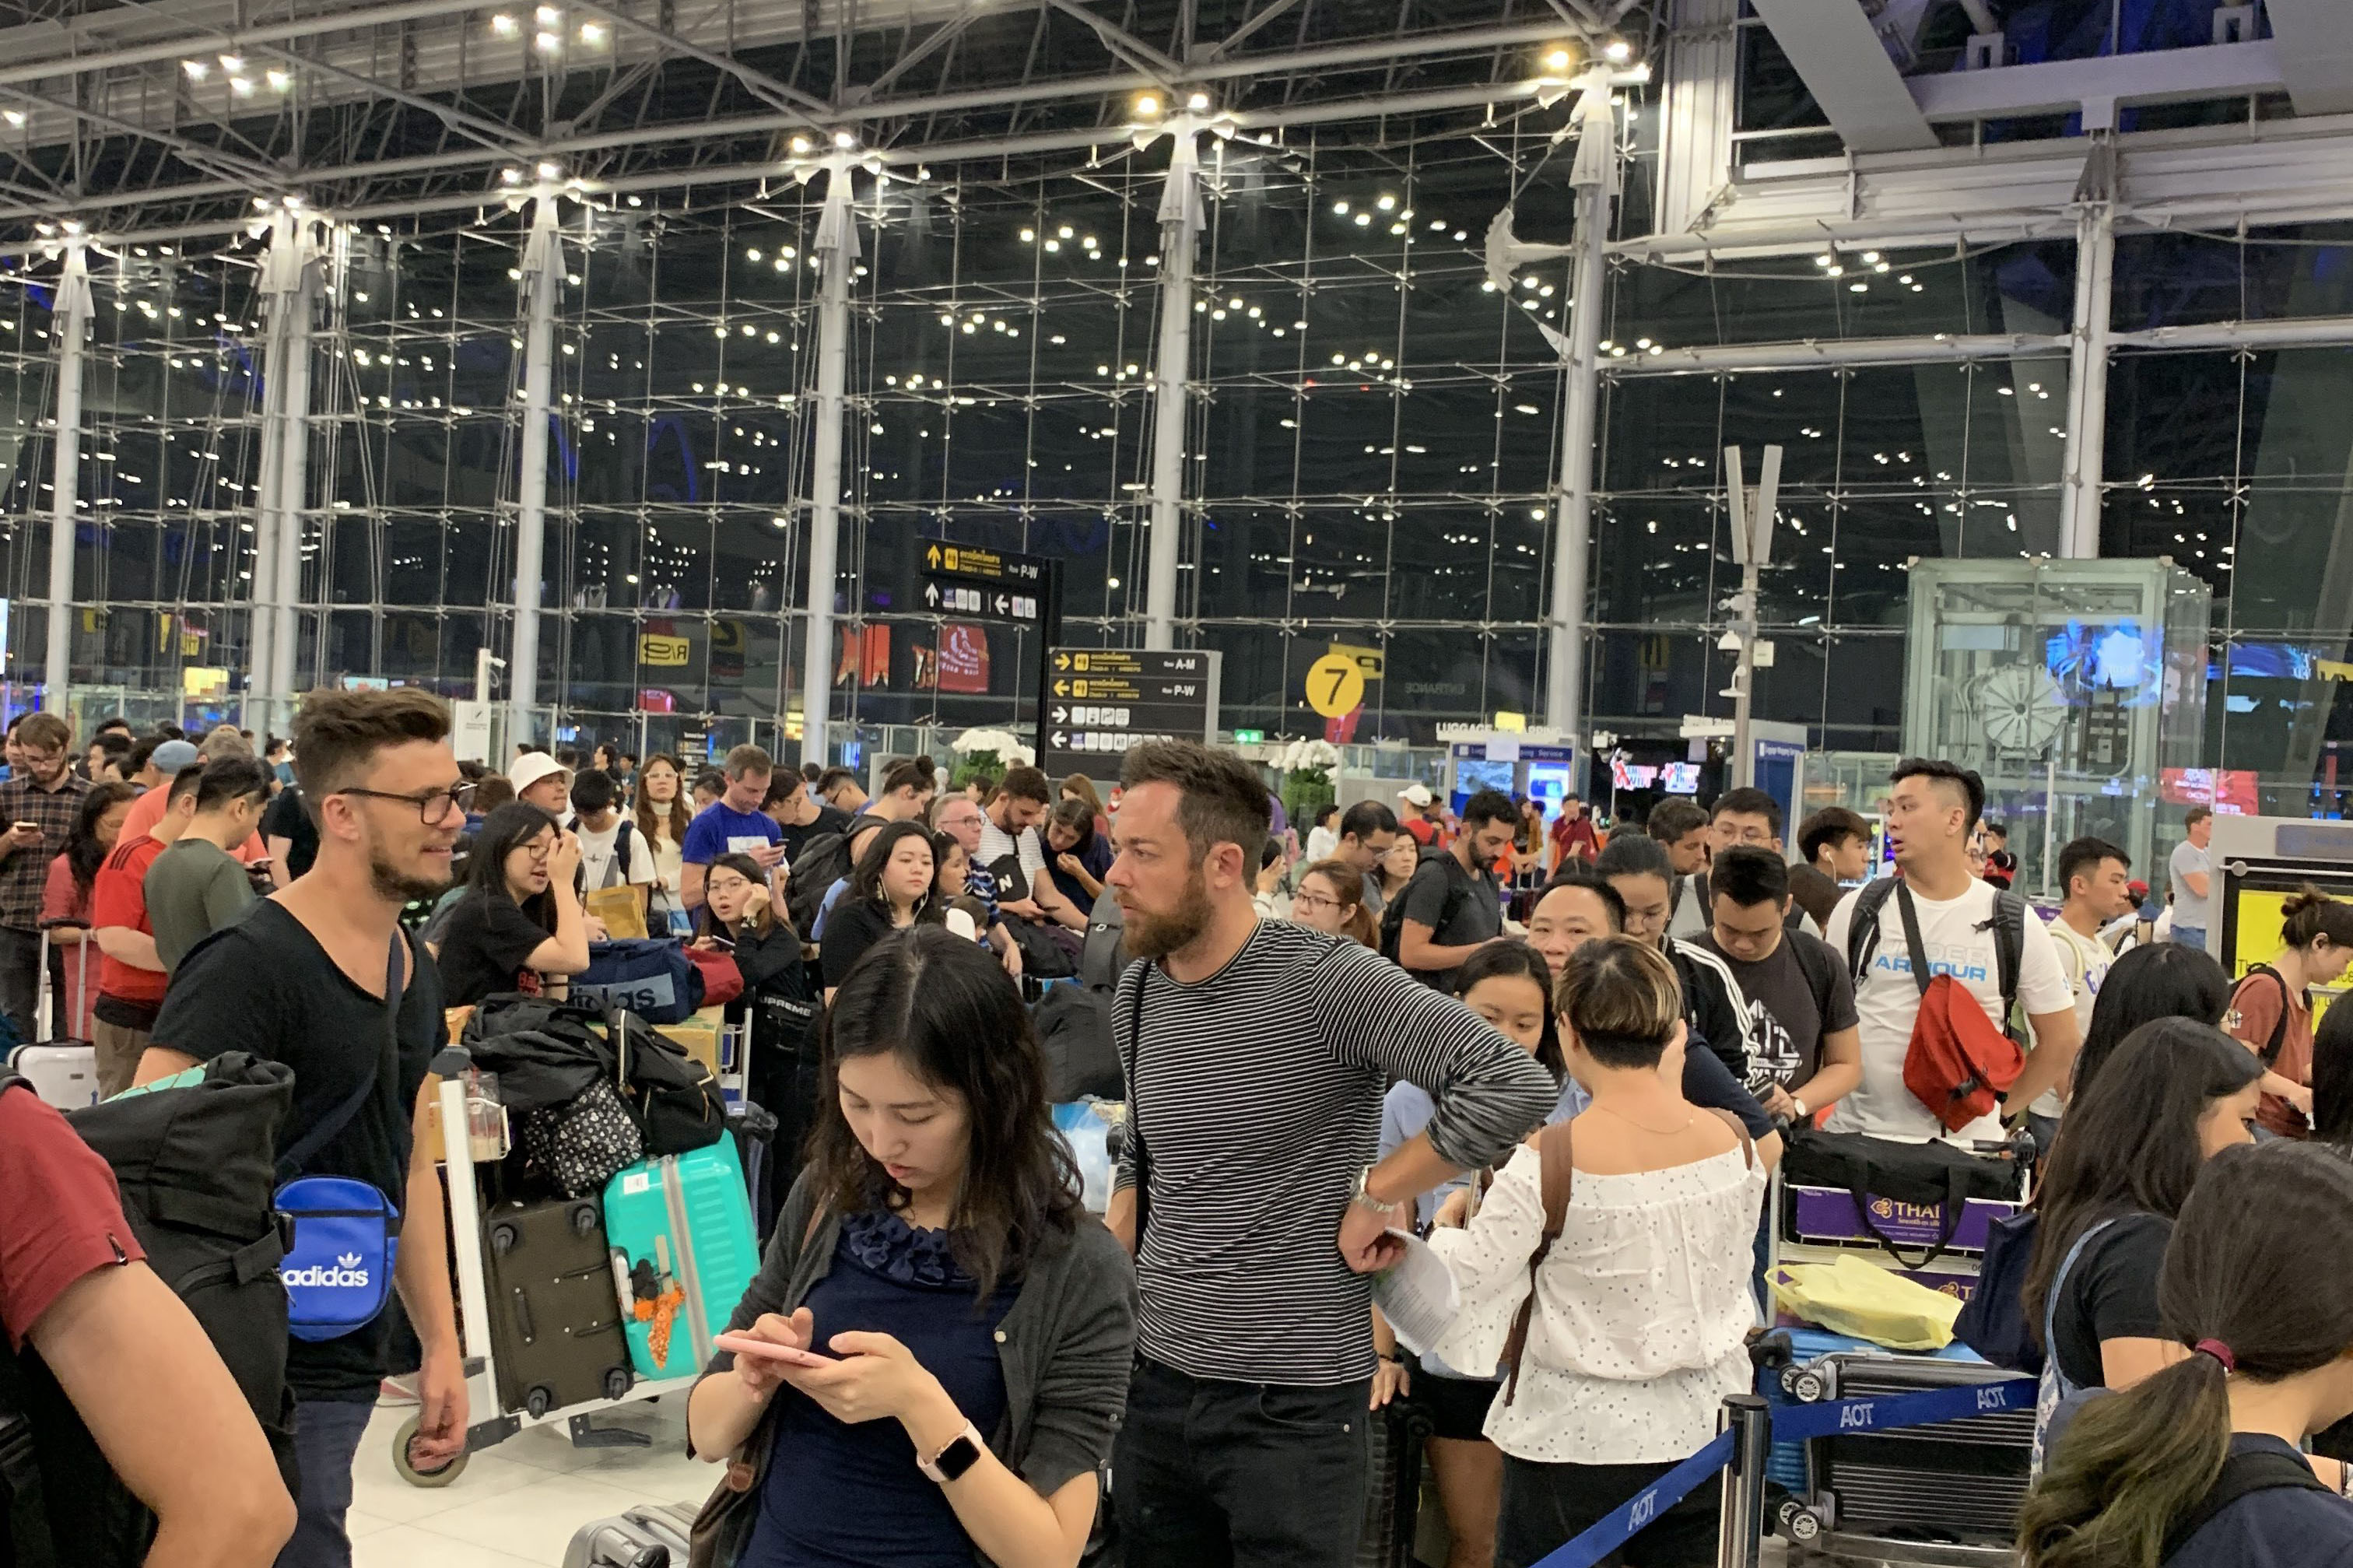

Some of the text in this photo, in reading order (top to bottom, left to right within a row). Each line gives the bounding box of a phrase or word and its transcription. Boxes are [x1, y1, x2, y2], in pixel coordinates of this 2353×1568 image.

[1021, 564, 1038, 579] P-W
[1175, 659, 1195, 669] A-M
[1174, 685, 1195, 696] P-W
[1324, 668, 1348, 706] 7
[759, 996, 811, 1016] UPREME
[1894, 1201, 1940, 1219] THAI
[282, 1265, 369, 1286] adidas
[1976, 1386, 2006, 1410] AOT
[1839, 1402, 1874, 1429] AOT
[1628, 1489, 1658, 1531] AOT
